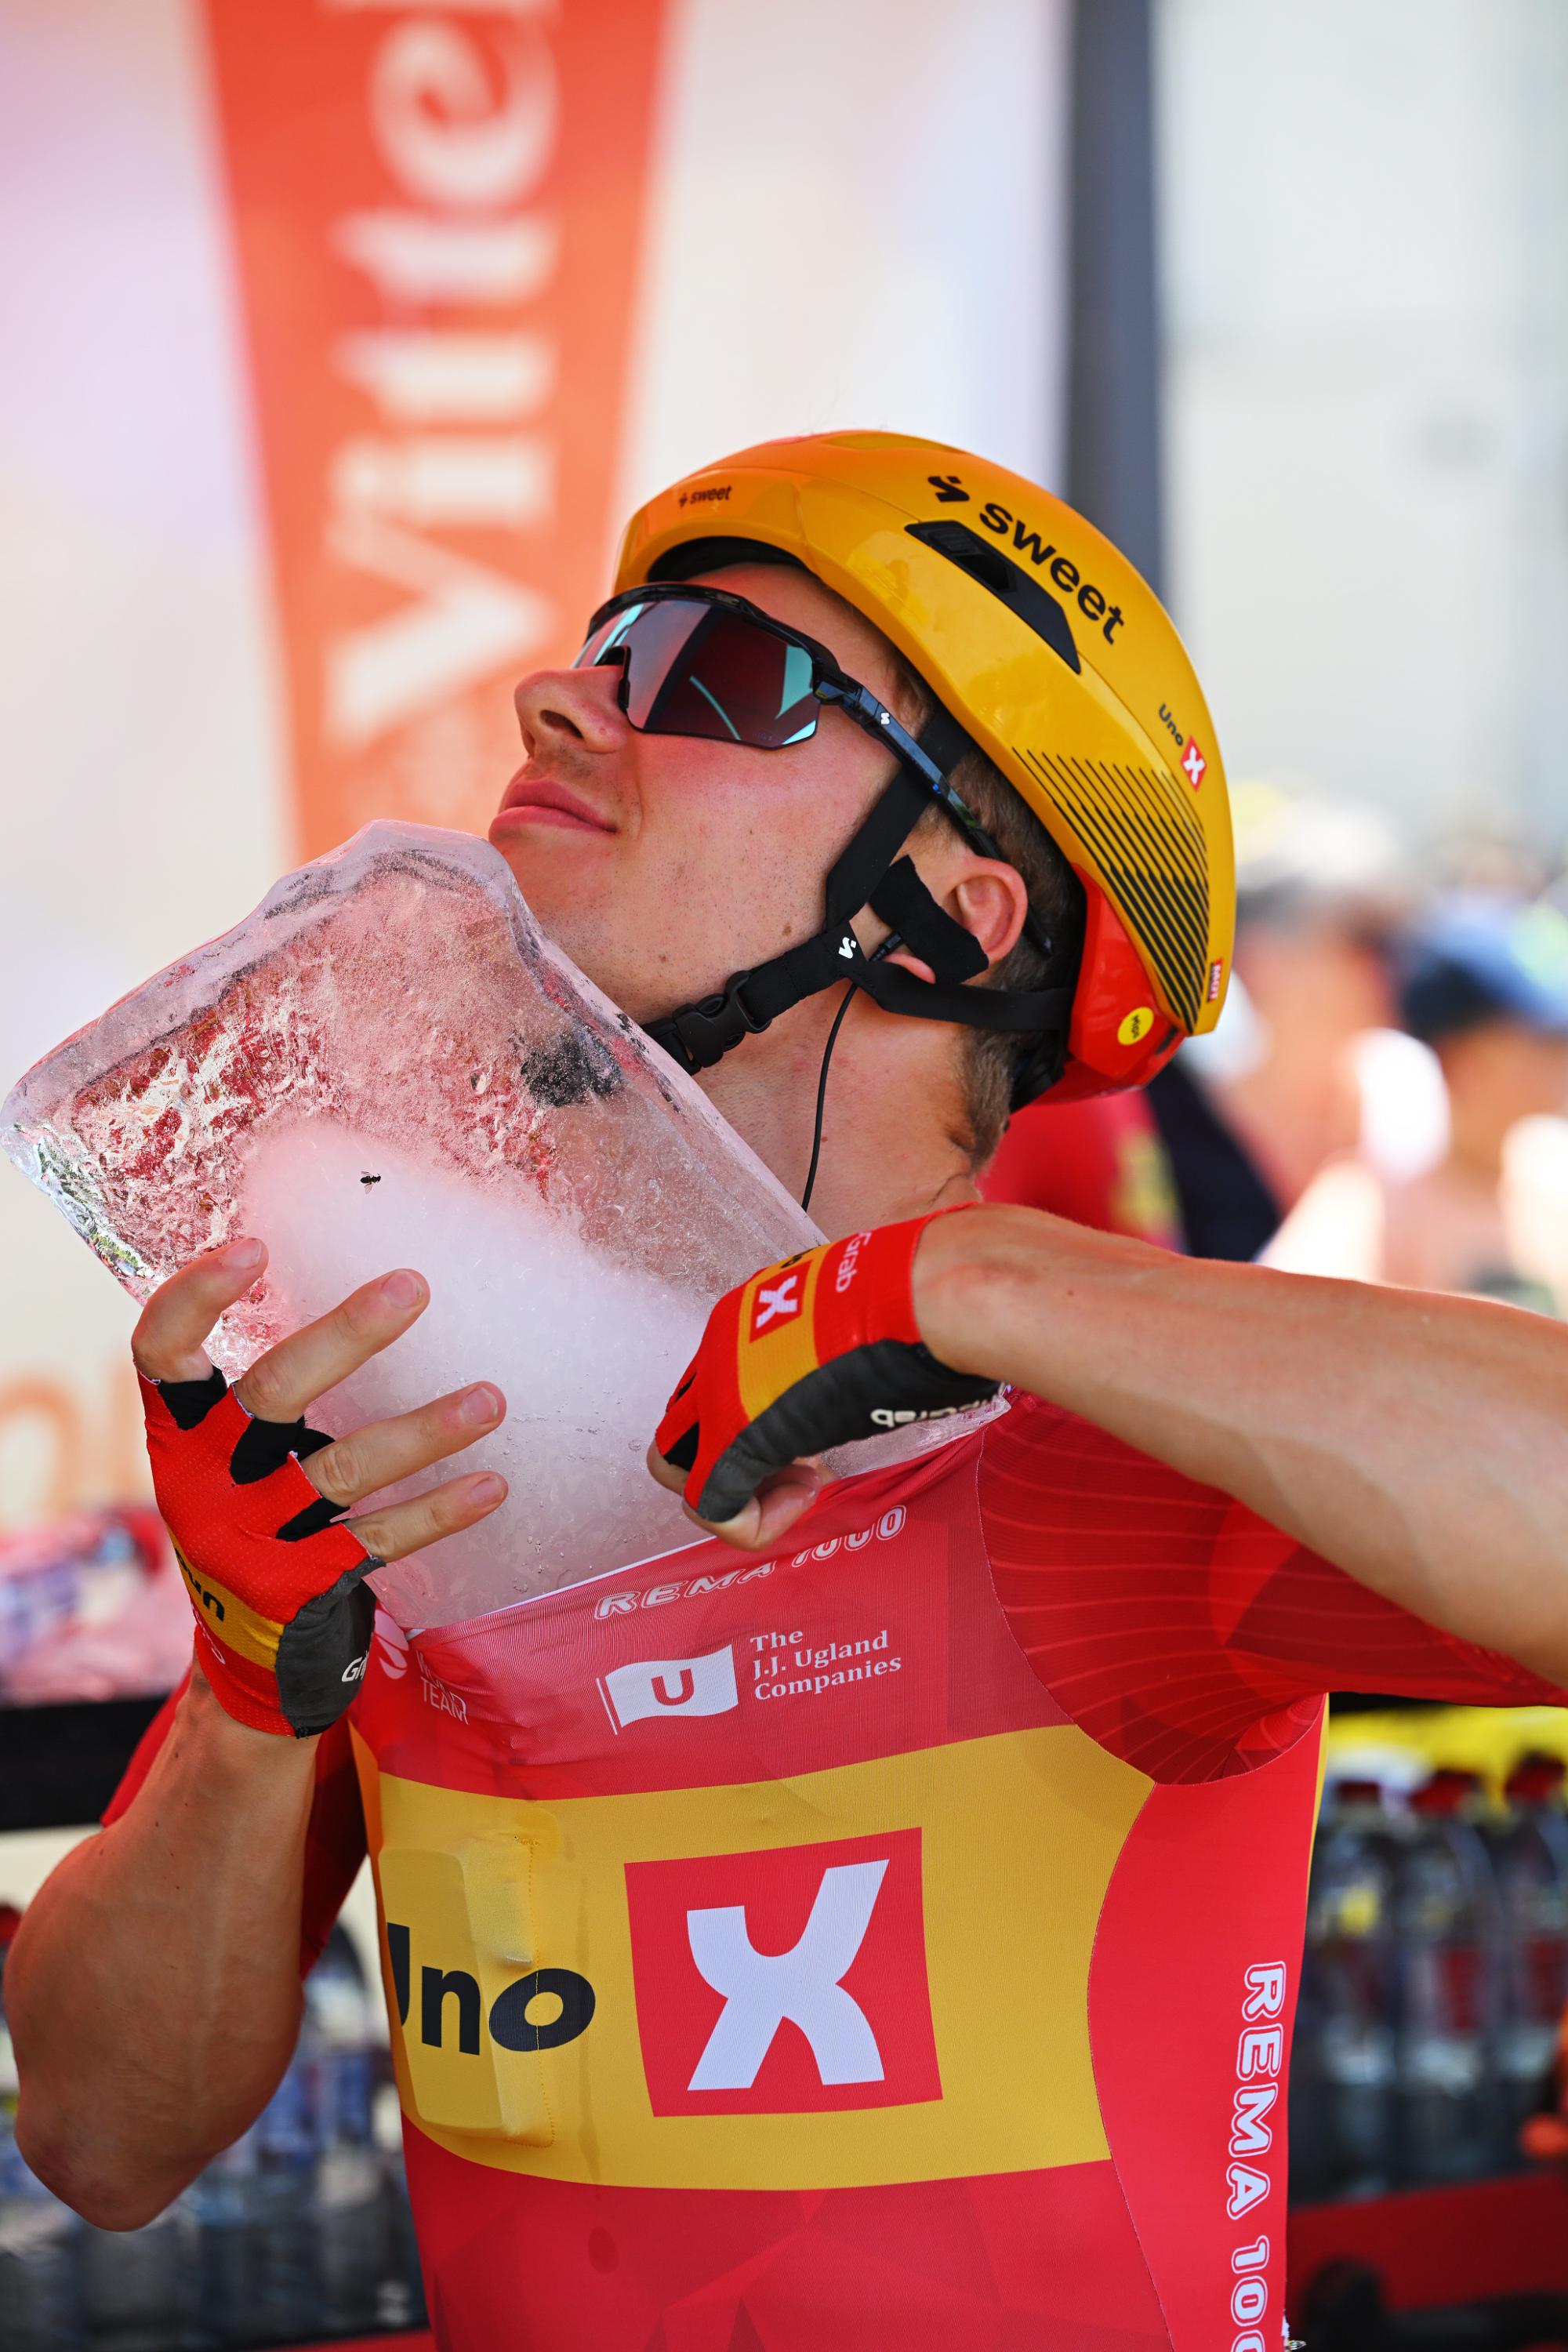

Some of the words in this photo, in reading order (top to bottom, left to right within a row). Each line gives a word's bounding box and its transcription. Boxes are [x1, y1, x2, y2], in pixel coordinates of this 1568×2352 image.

[321, 0, 564, 746] Vitte
[690, 485, 732, 505] sweet
[979, 503, 1124, 645] sweet
[1158, 703, 1184, 746] Uno
[1182, 746, 1206, 786] X
[750, 1630, 803, 1652] The
[753, 1656, 786, 1681] J.J.
[795, 1630, 889, 1668] Ugland
[650, 1668, 696, 1707] U
[754, 1657, 902, 1700] Companies
[686, 1858, 891, 2092] X
[1225, 1960, 1287, 2220] REMA
